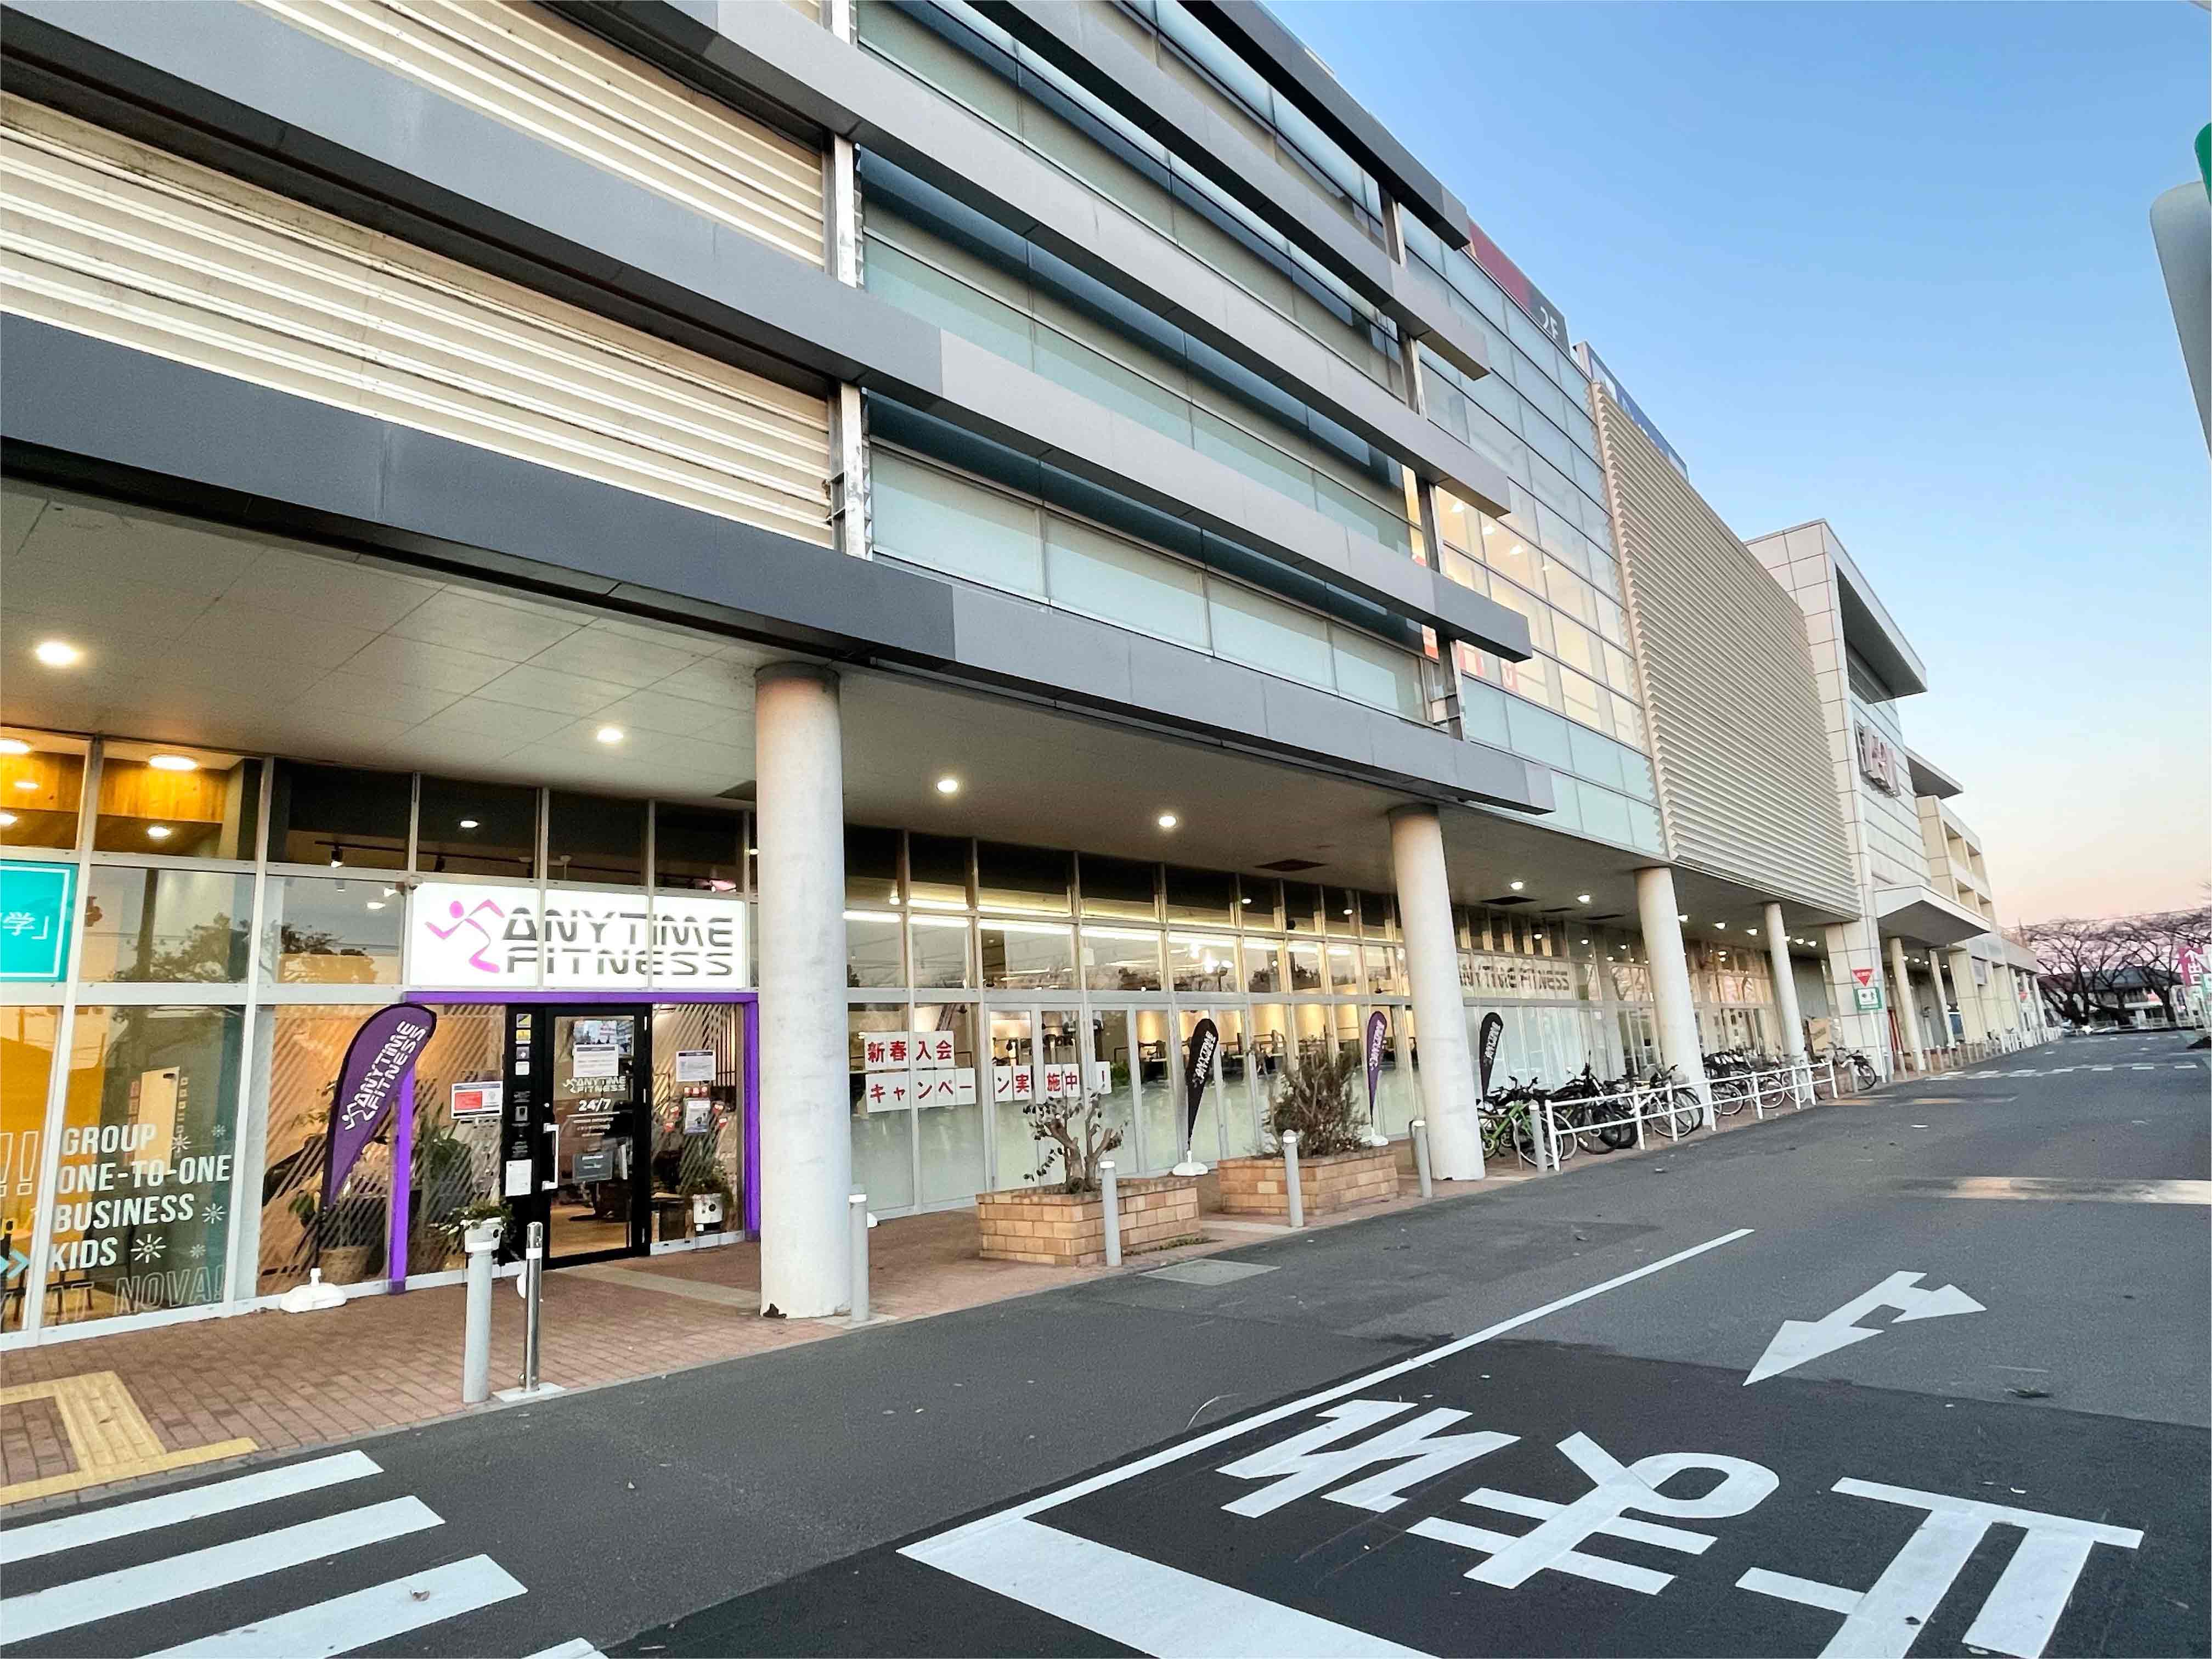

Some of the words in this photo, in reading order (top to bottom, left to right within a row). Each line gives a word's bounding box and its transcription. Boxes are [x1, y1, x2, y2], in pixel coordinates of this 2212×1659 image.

[0, 911, 49, 940] 学」
[502, 907, 733, 947] ANYTIME
[506, 946, 733, 976] FITNESS
[353, 1020, 414, 1109] ANYTIME
[366, 1025, 427, 1110] FITNESS
[867, 1040, 952, 1063] 新春入会
[578, 1097, 612, 1112] 24/7
[61, 1124, 158, 1156] GROUP
[57, 1155, 232, 1194] ONE-TO-ONE
[53, 1193, 195, 1233] BUSINESS
[48, 1237, 119, 1272] KIDS
[114, 1265, 225, 1316] NOVA!
